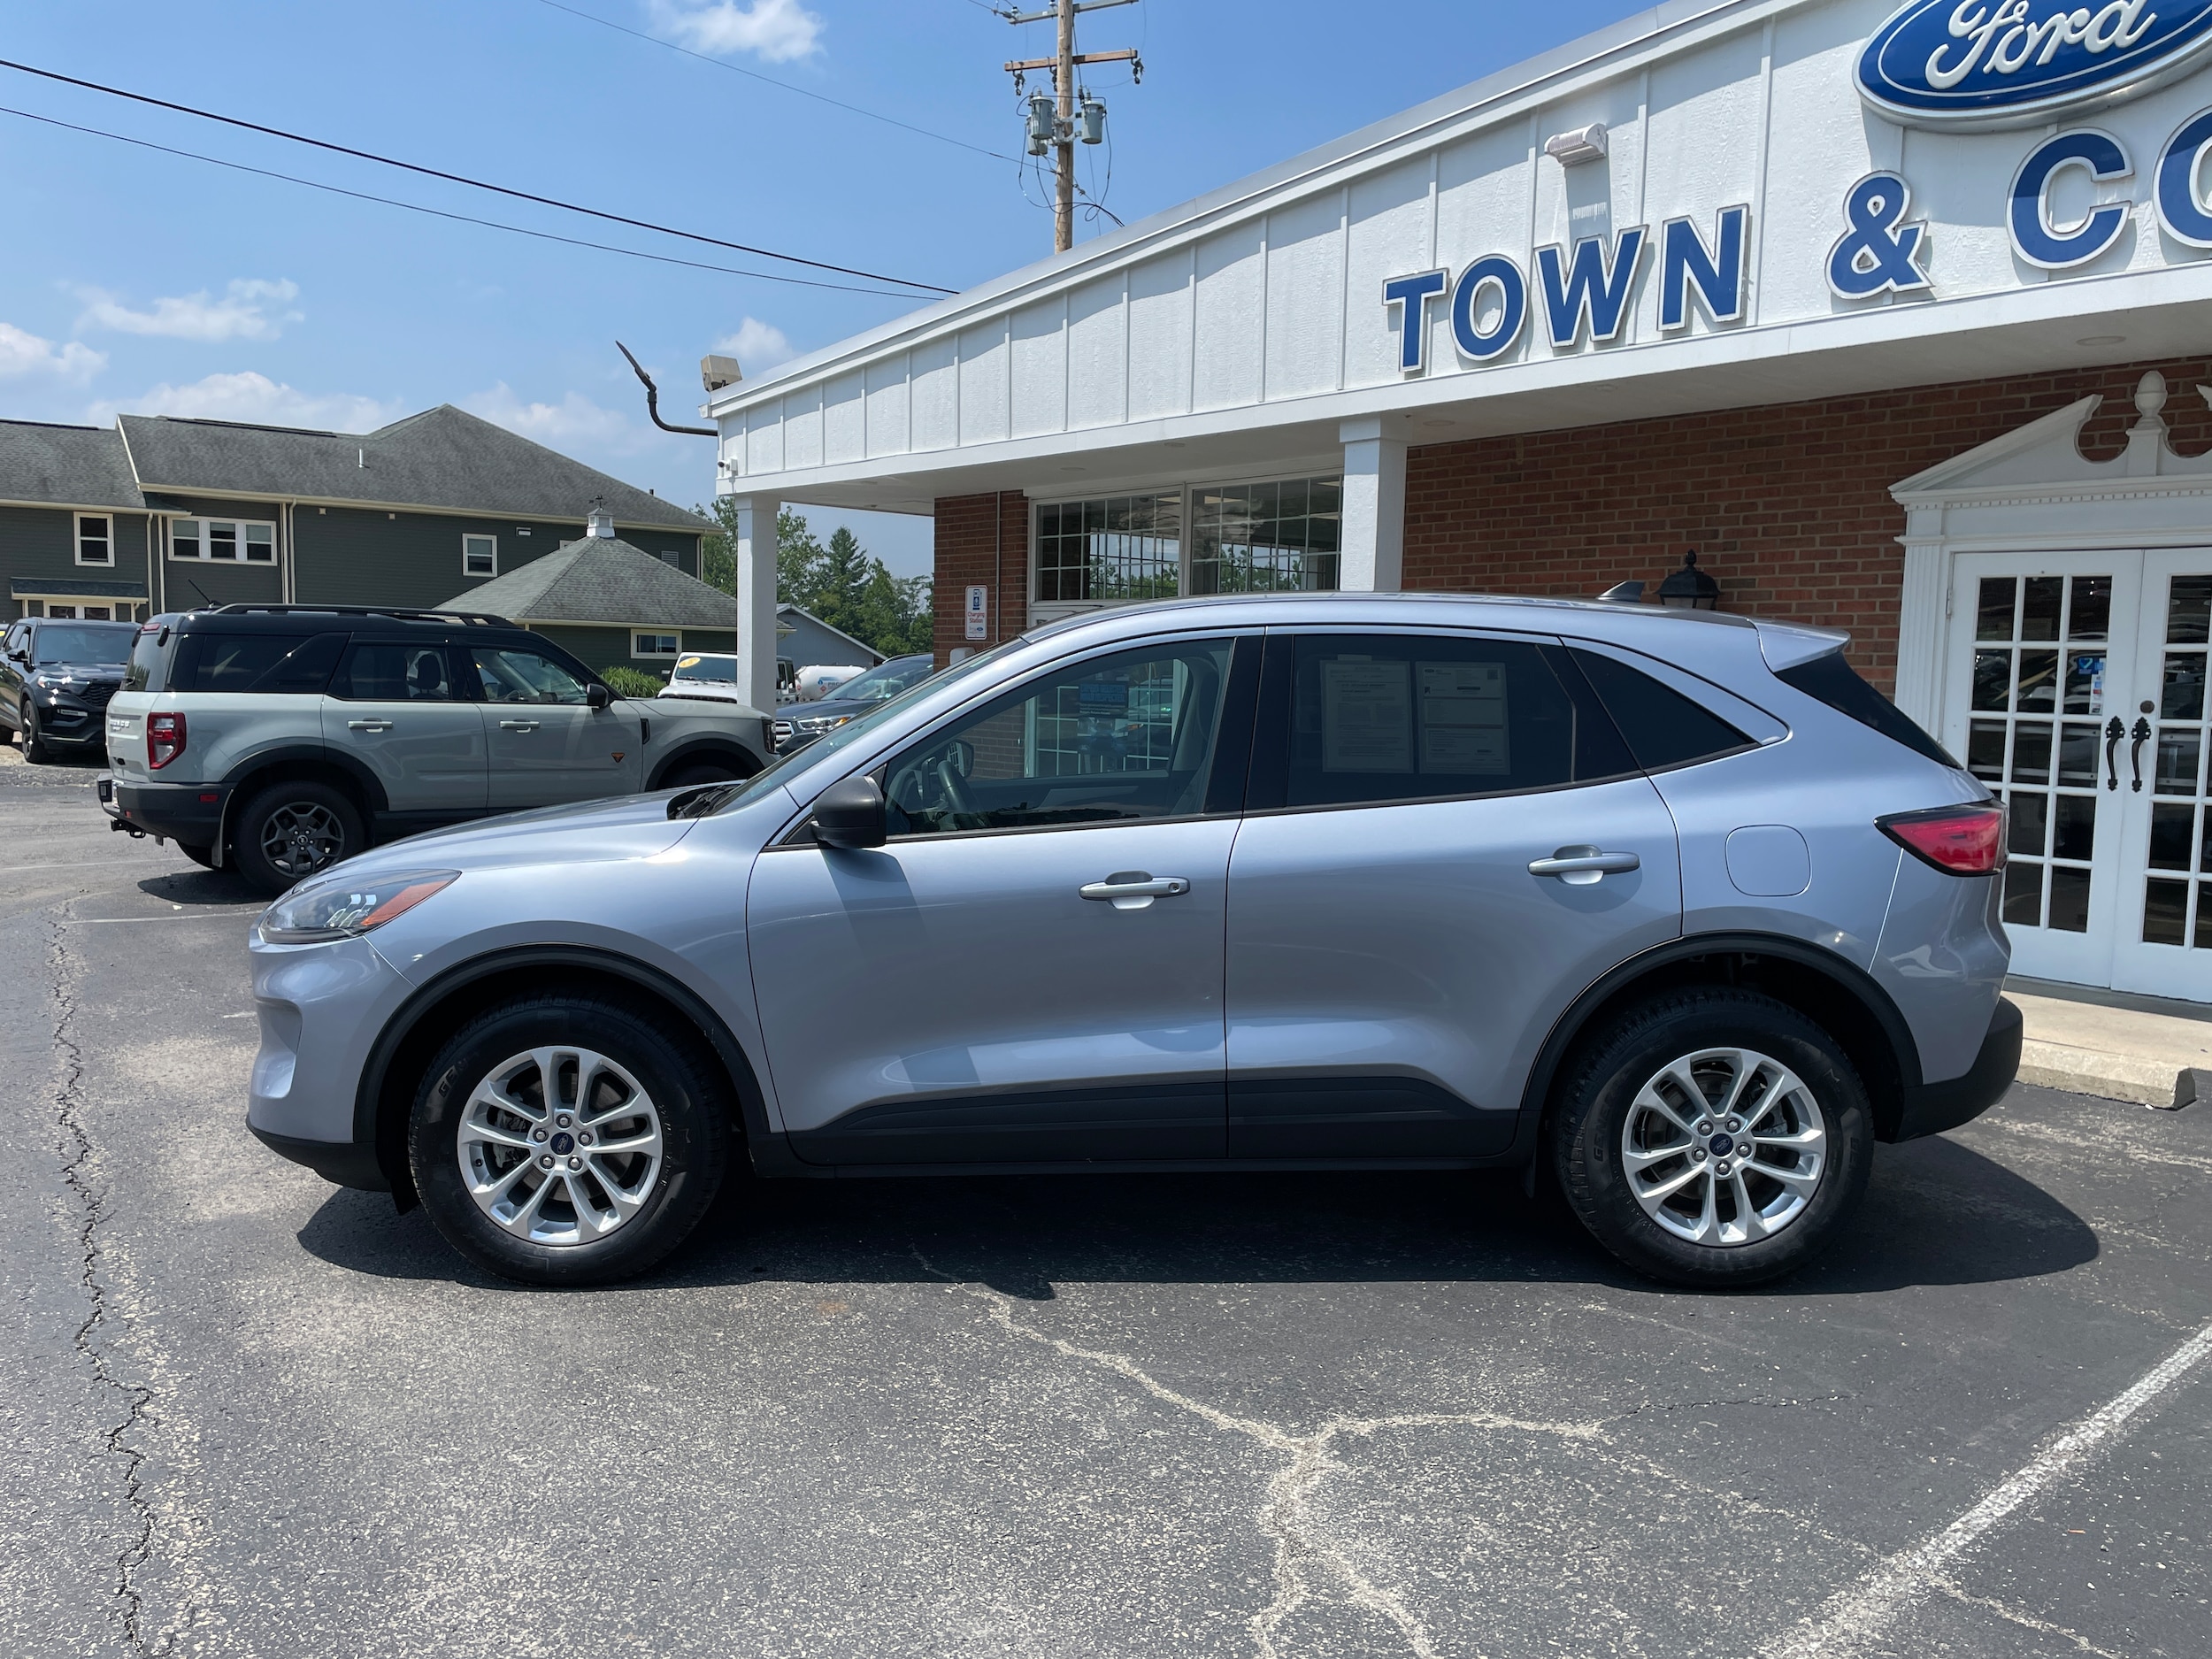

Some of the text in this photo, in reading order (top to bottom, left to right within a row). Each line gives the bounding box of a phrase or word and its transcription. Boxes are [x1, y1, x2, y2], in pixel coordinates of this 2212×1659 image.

[1924, 0, 2158, 89] Ford
[1383, 204, 1749, 373] TOWN
[1826, 170, 1935, 300] &
